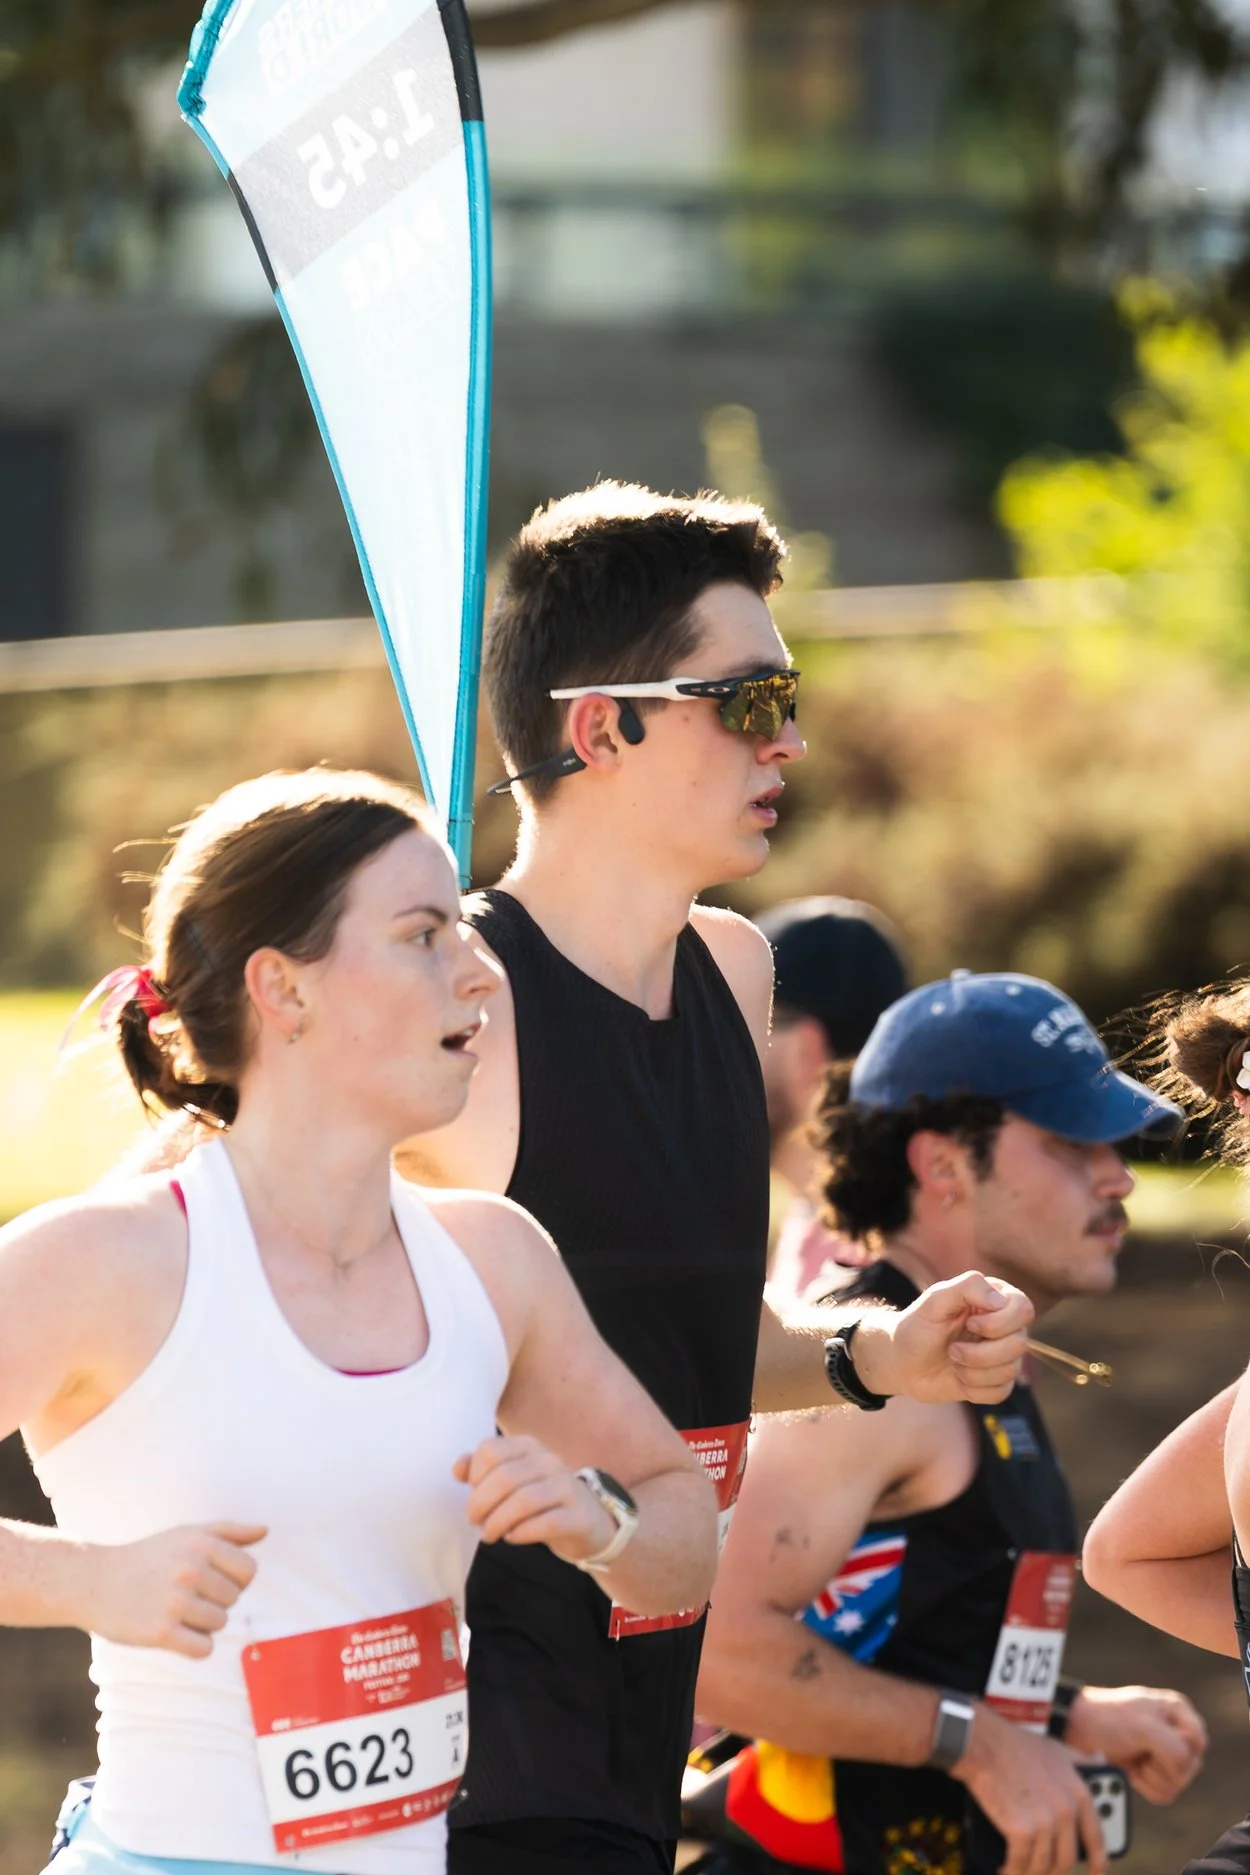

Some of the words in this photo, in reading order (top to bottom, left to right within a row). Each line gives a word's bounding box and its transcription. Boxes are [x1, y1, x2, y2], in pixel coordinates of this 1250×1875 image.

[340, 1633, 418, 1665] CANBERRA
[343, 1651, 421, 1684] MARATHON
[284, 1728, 414, 1800] 6623
